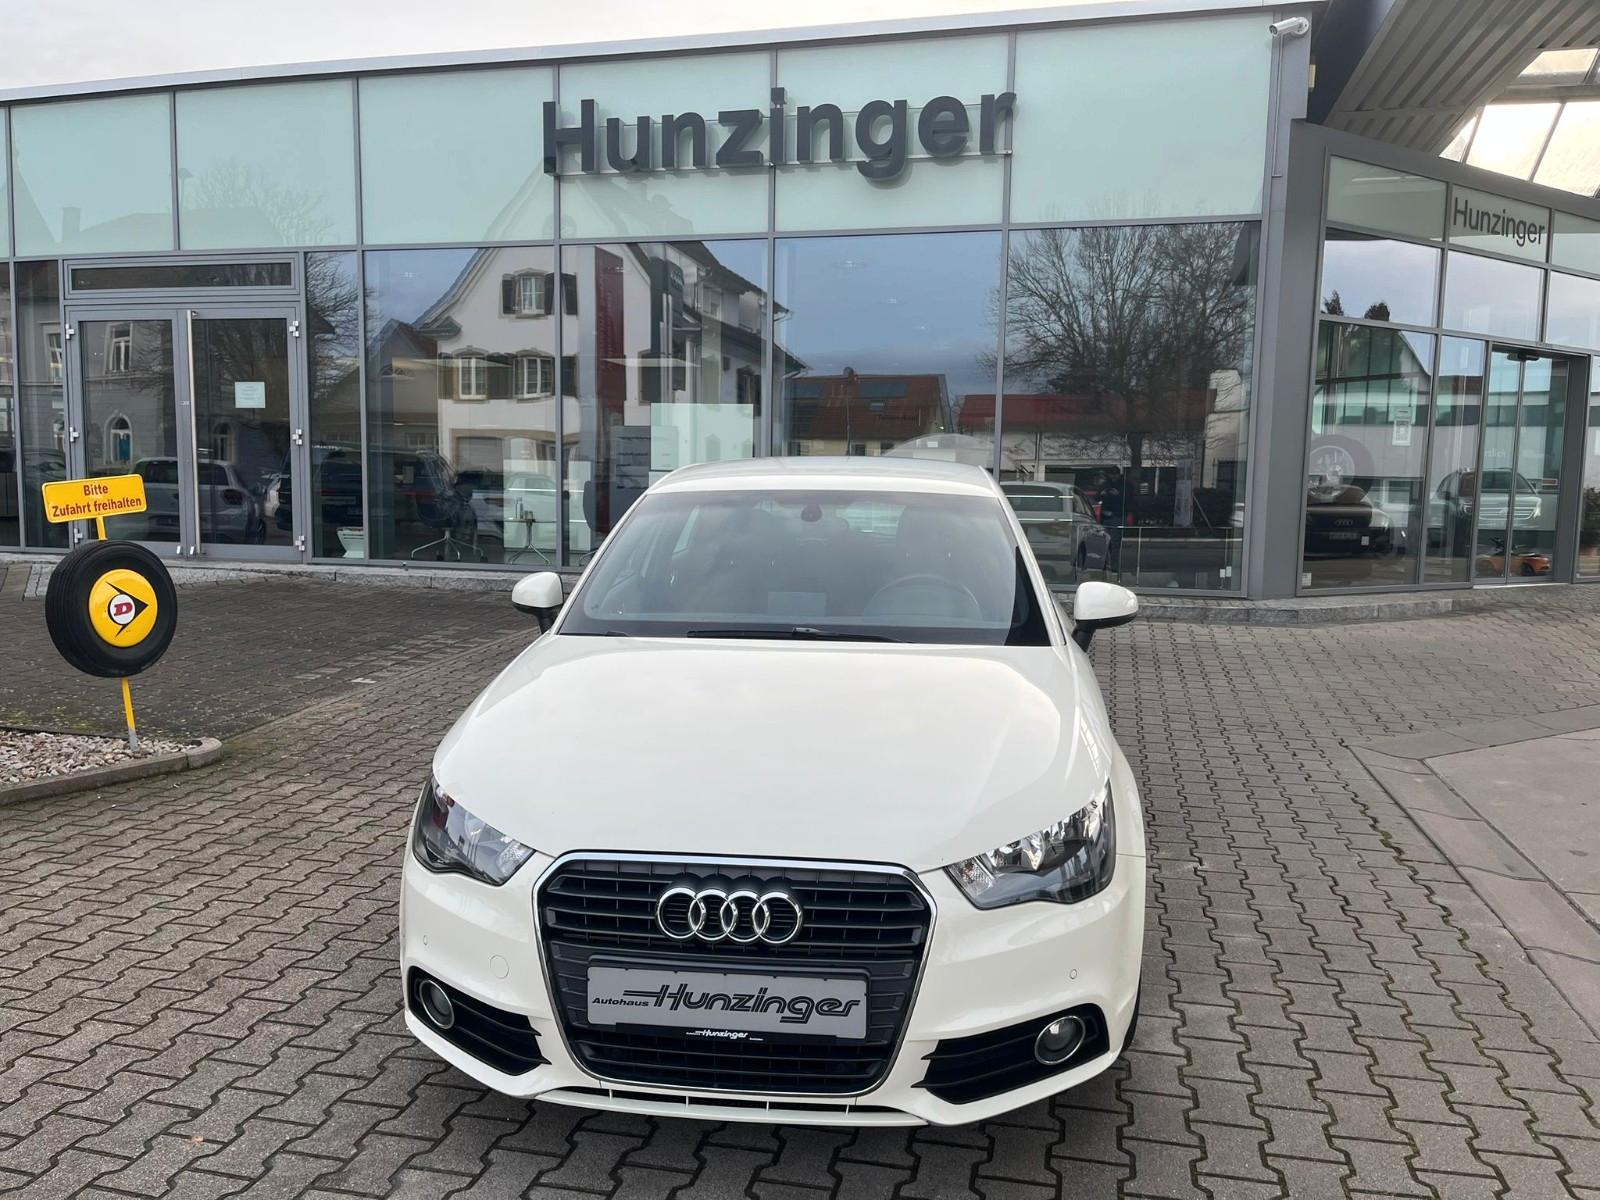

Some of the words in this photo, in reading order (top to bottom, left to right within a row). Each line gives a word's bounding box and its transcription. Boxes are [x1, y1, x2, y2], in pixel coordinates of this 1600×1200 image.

[543, 87, 1017, 182] Hunzinger
[1453, 197, 1546, 247] Hunzinger
[84, 484, 109, 496] Bitte
[52, 502, 91, 518] Zufahrt
[94, 496, 142, 512] freihalten
[113, 602, 133, 616] D
[591, 996, 650, 1007] Autohaus
[623, 983, 860, 1024] Hunzinger
[696, 1029, 749, 1040] Hunzinger
